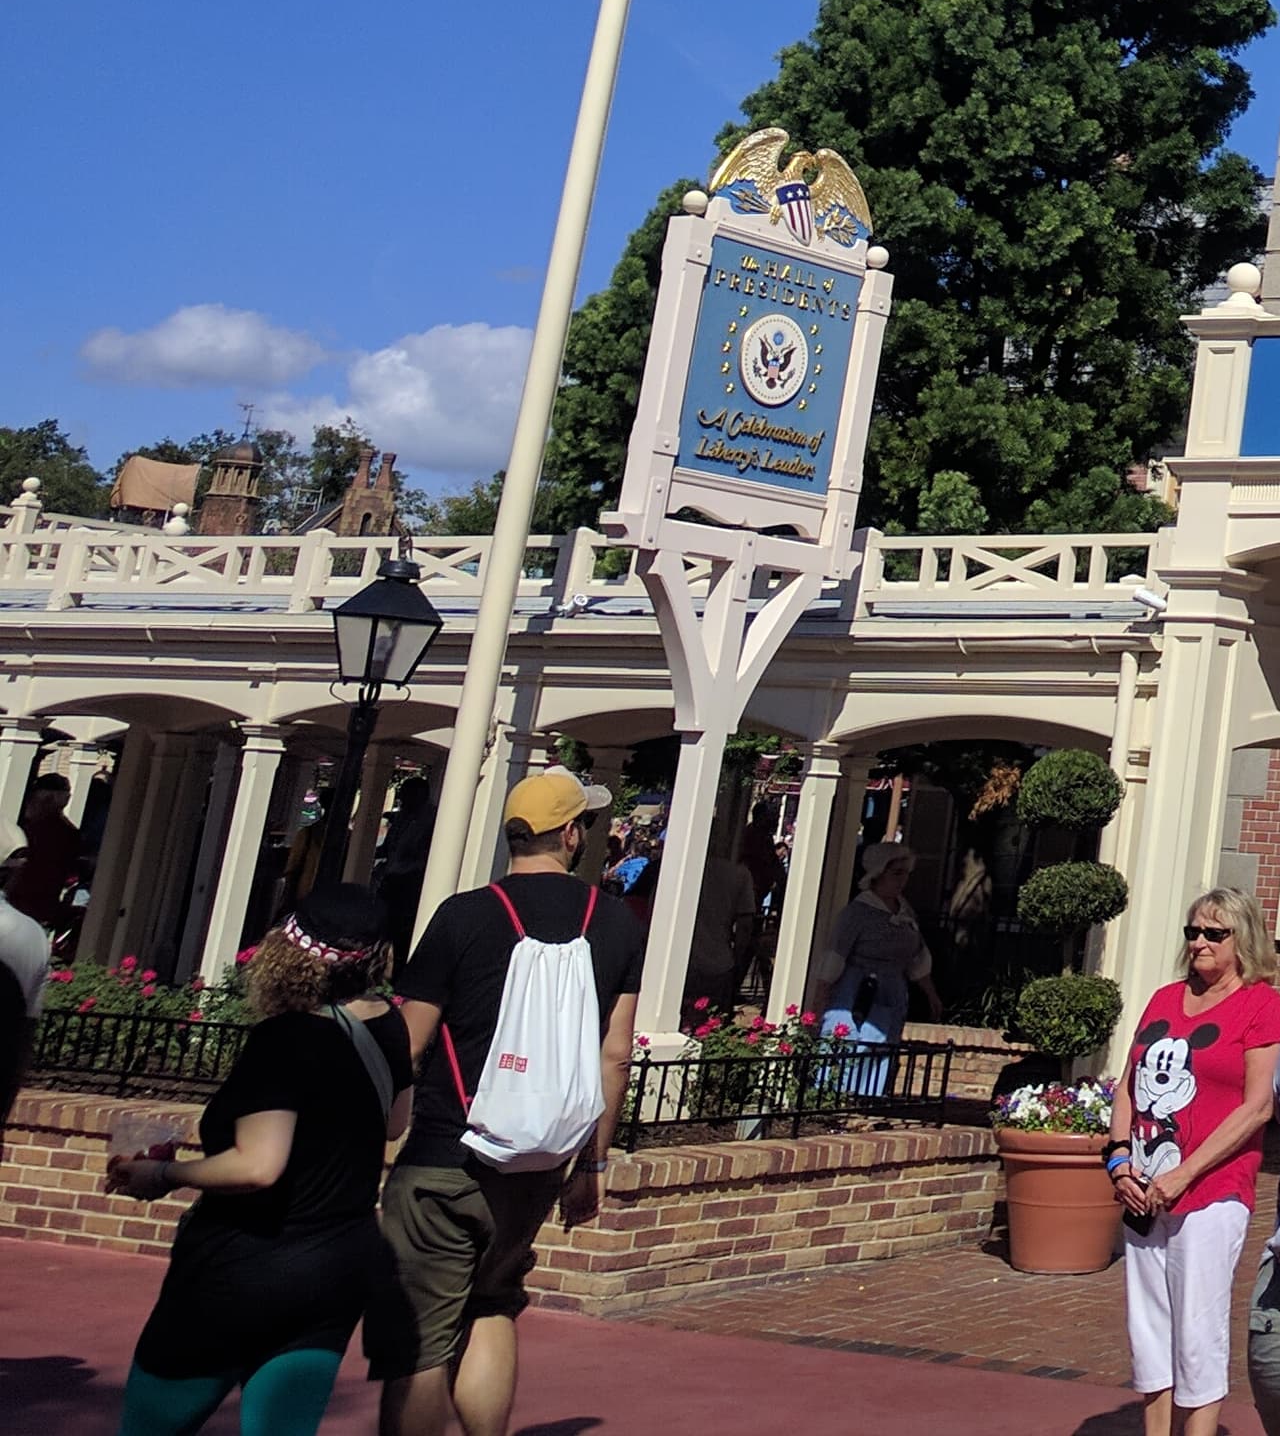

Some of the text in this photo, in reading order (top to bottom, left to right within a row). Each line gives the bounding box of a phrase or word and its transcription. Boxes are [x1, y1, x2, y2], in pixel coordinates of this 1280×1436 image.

[714, 268, 851, 321] PRESIDENTS
[764, 259, 817, 289] HALL
[822, 277, 835, 294] of
[697, 407, 826, 456] A Celebration of
[695, 435, 816, 480] Liberty's Leaders
